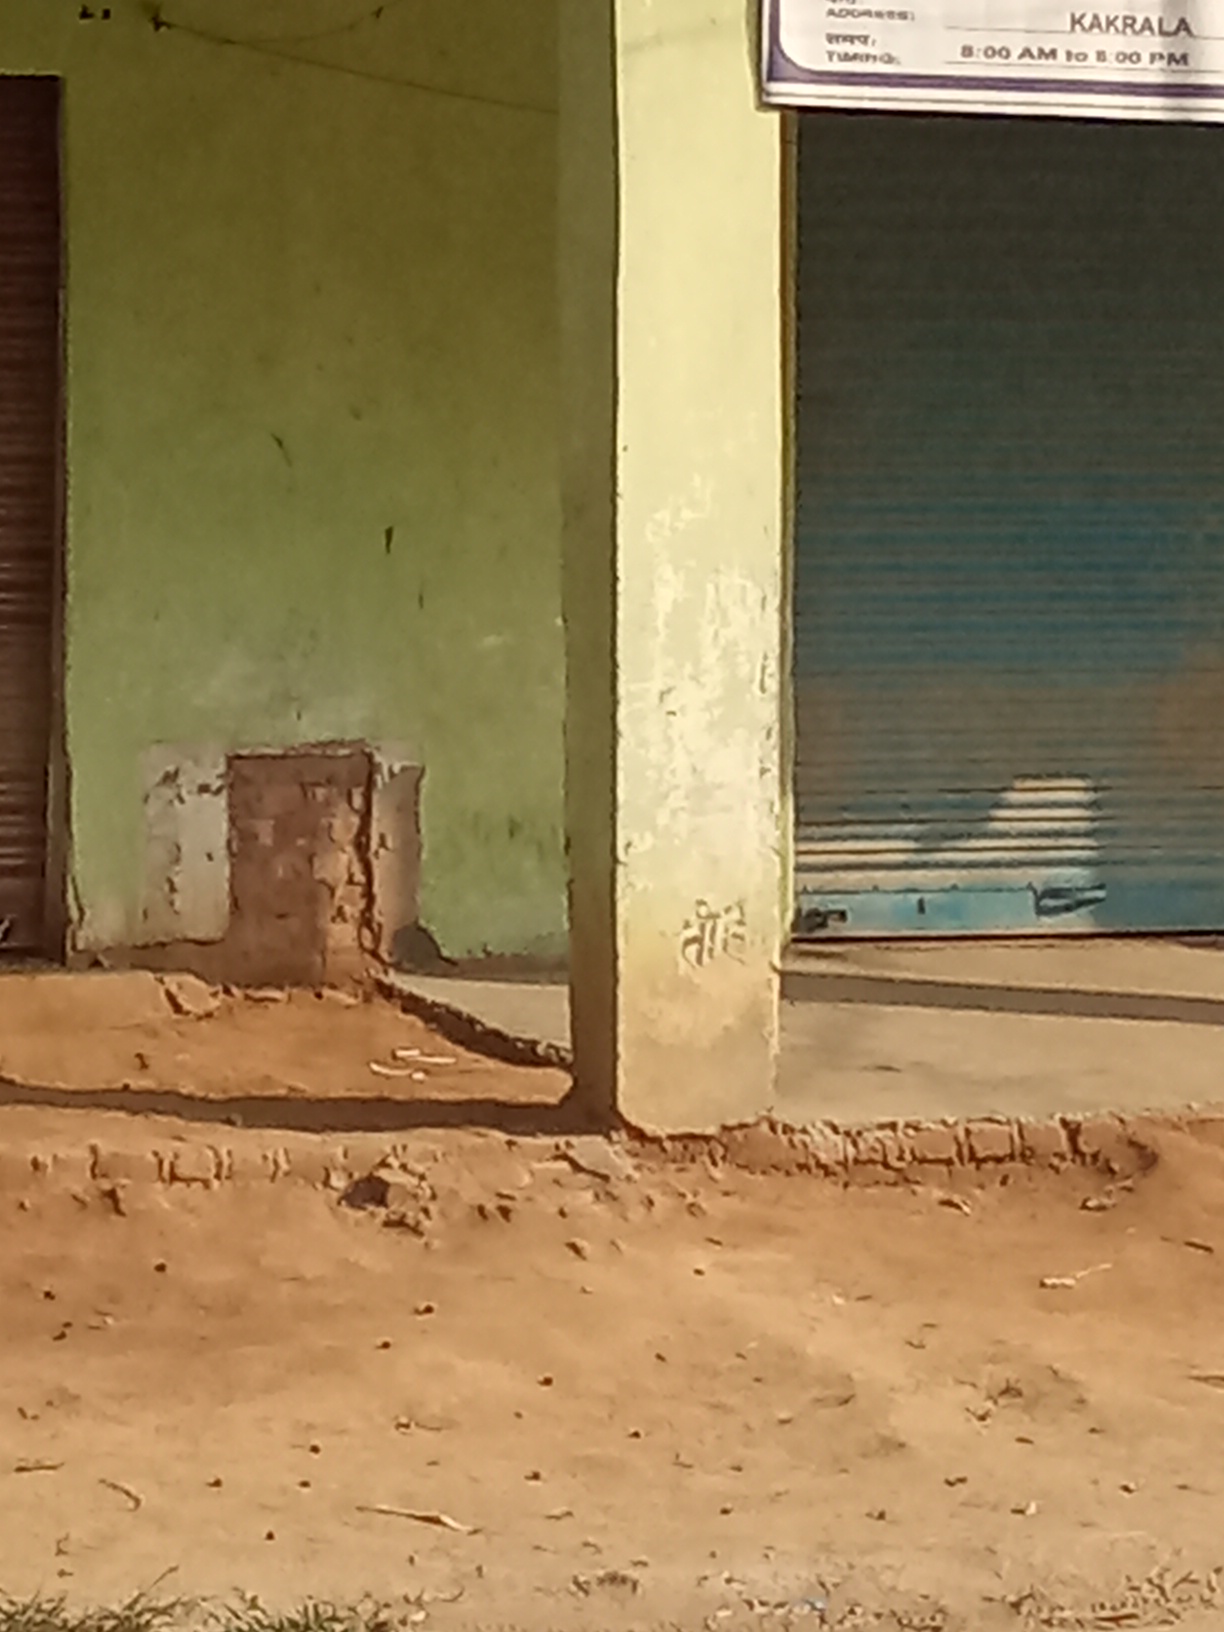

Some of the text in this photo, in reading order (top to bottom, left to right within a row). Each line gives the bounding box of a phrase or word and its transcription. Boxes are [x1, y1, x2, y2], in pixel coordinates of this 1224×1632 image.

[1070, 12, 1194, 38] KAKRALA
[1018, 46, 1058, 61] AM
[1065, 49, 1089, 63] to
[1149, 51, 1190, 67] PM
